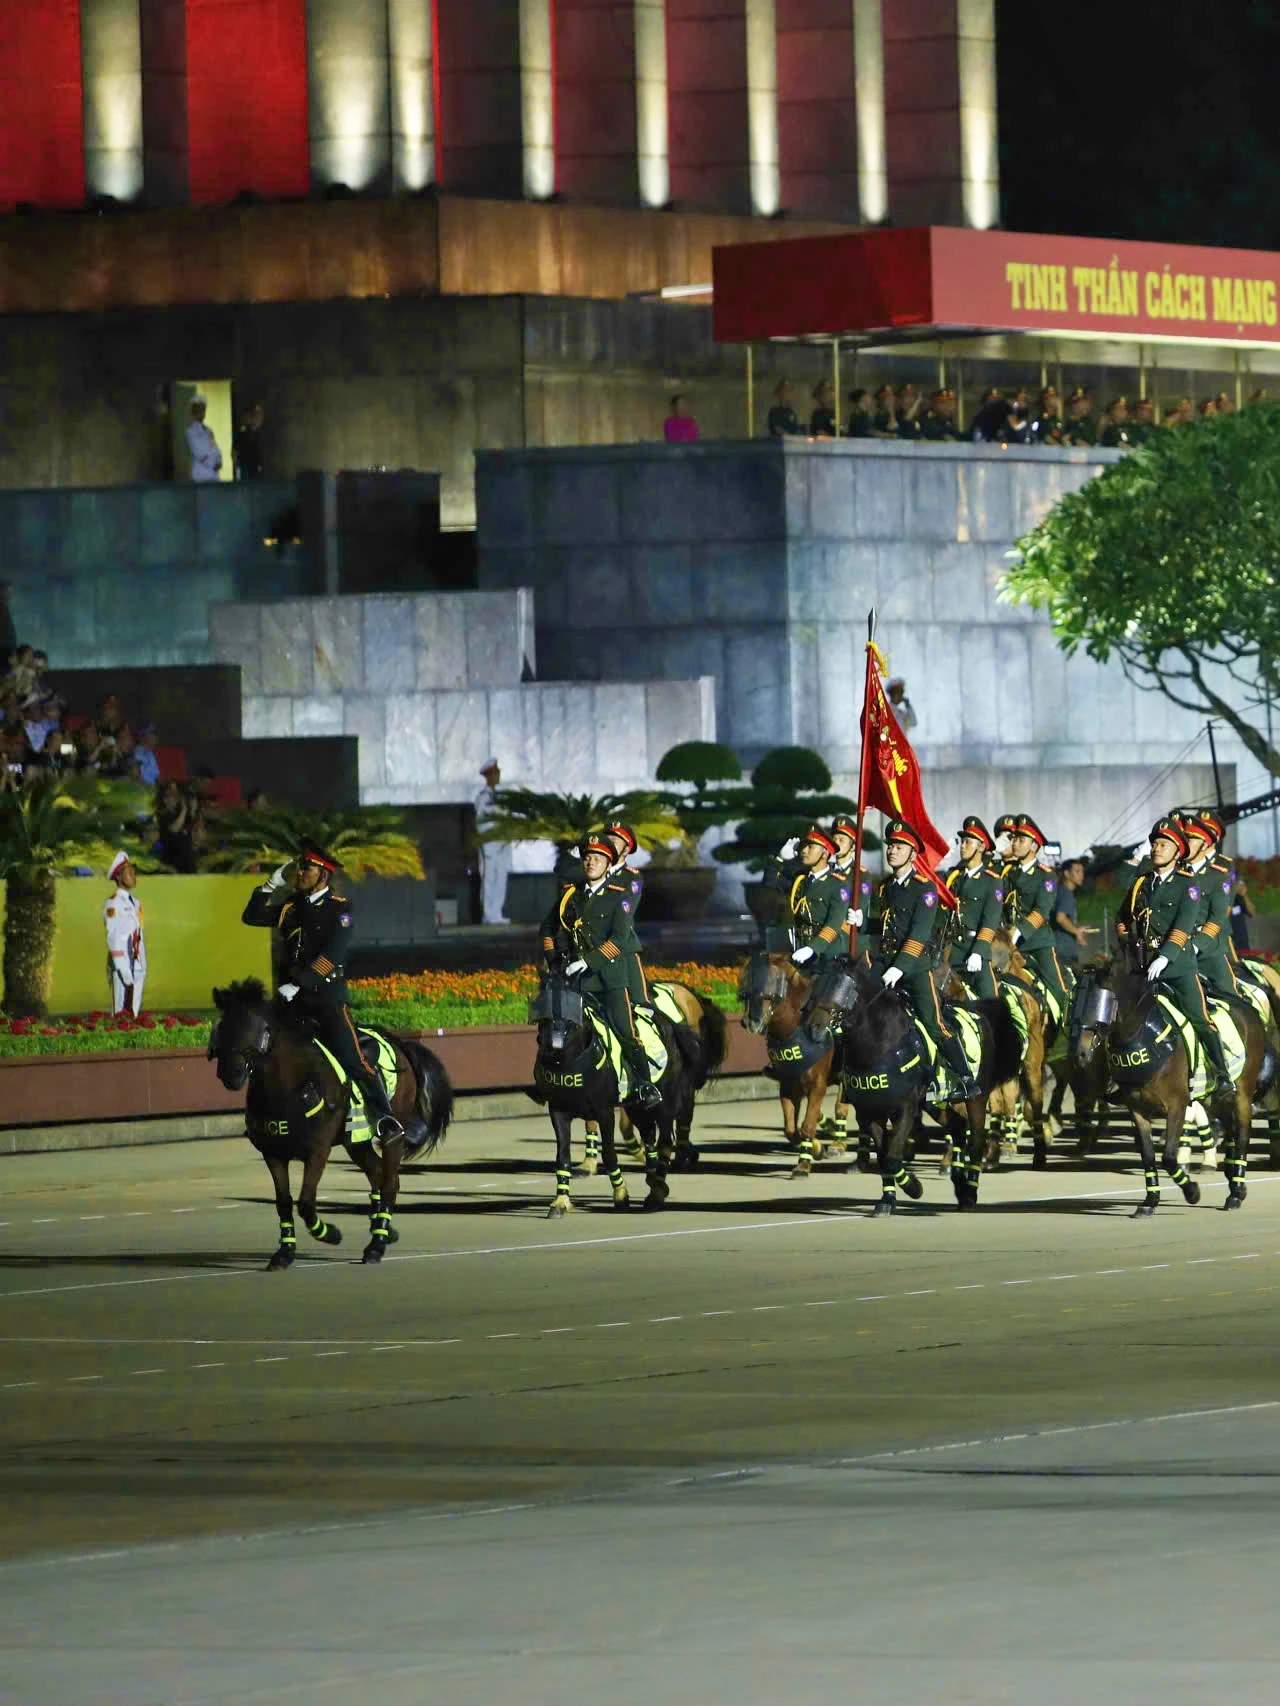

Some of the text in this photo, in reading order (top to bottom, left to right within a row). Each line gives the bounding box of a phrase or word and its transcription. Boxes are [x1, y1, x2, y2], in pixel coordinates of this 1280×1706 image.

[1006, 261, 1068, 312] TINH
[1144, 264, 1207, 321] CÁCH
[1211, 276, 1277, 333] MẠNG
